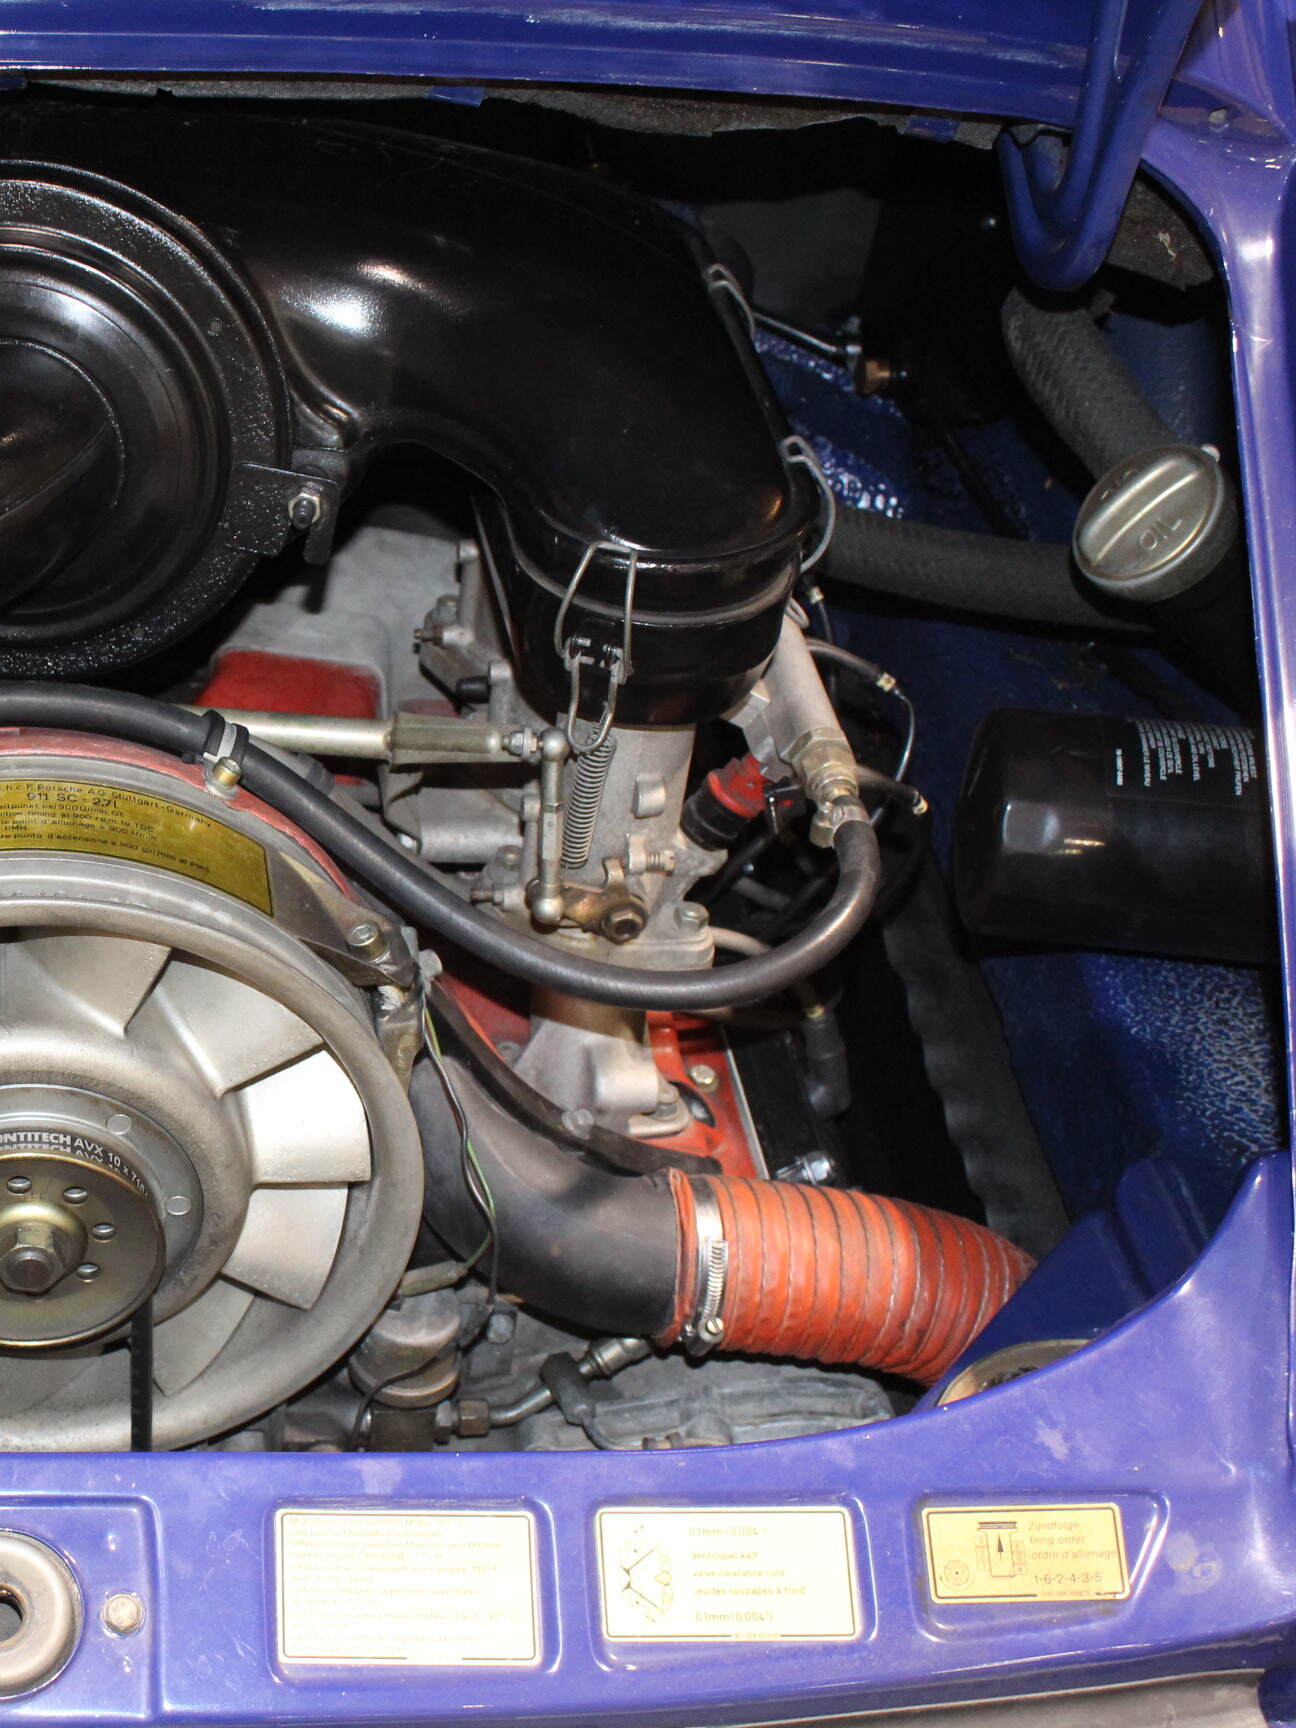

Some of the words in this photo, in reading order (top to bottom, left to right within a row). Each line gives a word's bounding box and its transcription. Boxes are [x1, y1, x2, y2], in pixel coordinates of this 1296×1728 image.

[1138, 519, 1184, 551] OIL
[37, 784, 83, 793] Porsche
[27, 792, 49, 800] 911
[57, 793, 77, 802] SC
[74, 1138, 103, 1156] AVX
[107, 1152, 120, 1167] 10
[1028, 1521, 1080, 1531] Zündfolge
[1030, 1536, 1054, 1545] firing
[1058, 1536, 1087, 1544] order
[1034, 1571, 1102, 1584] 1-6-2-4-3-5
